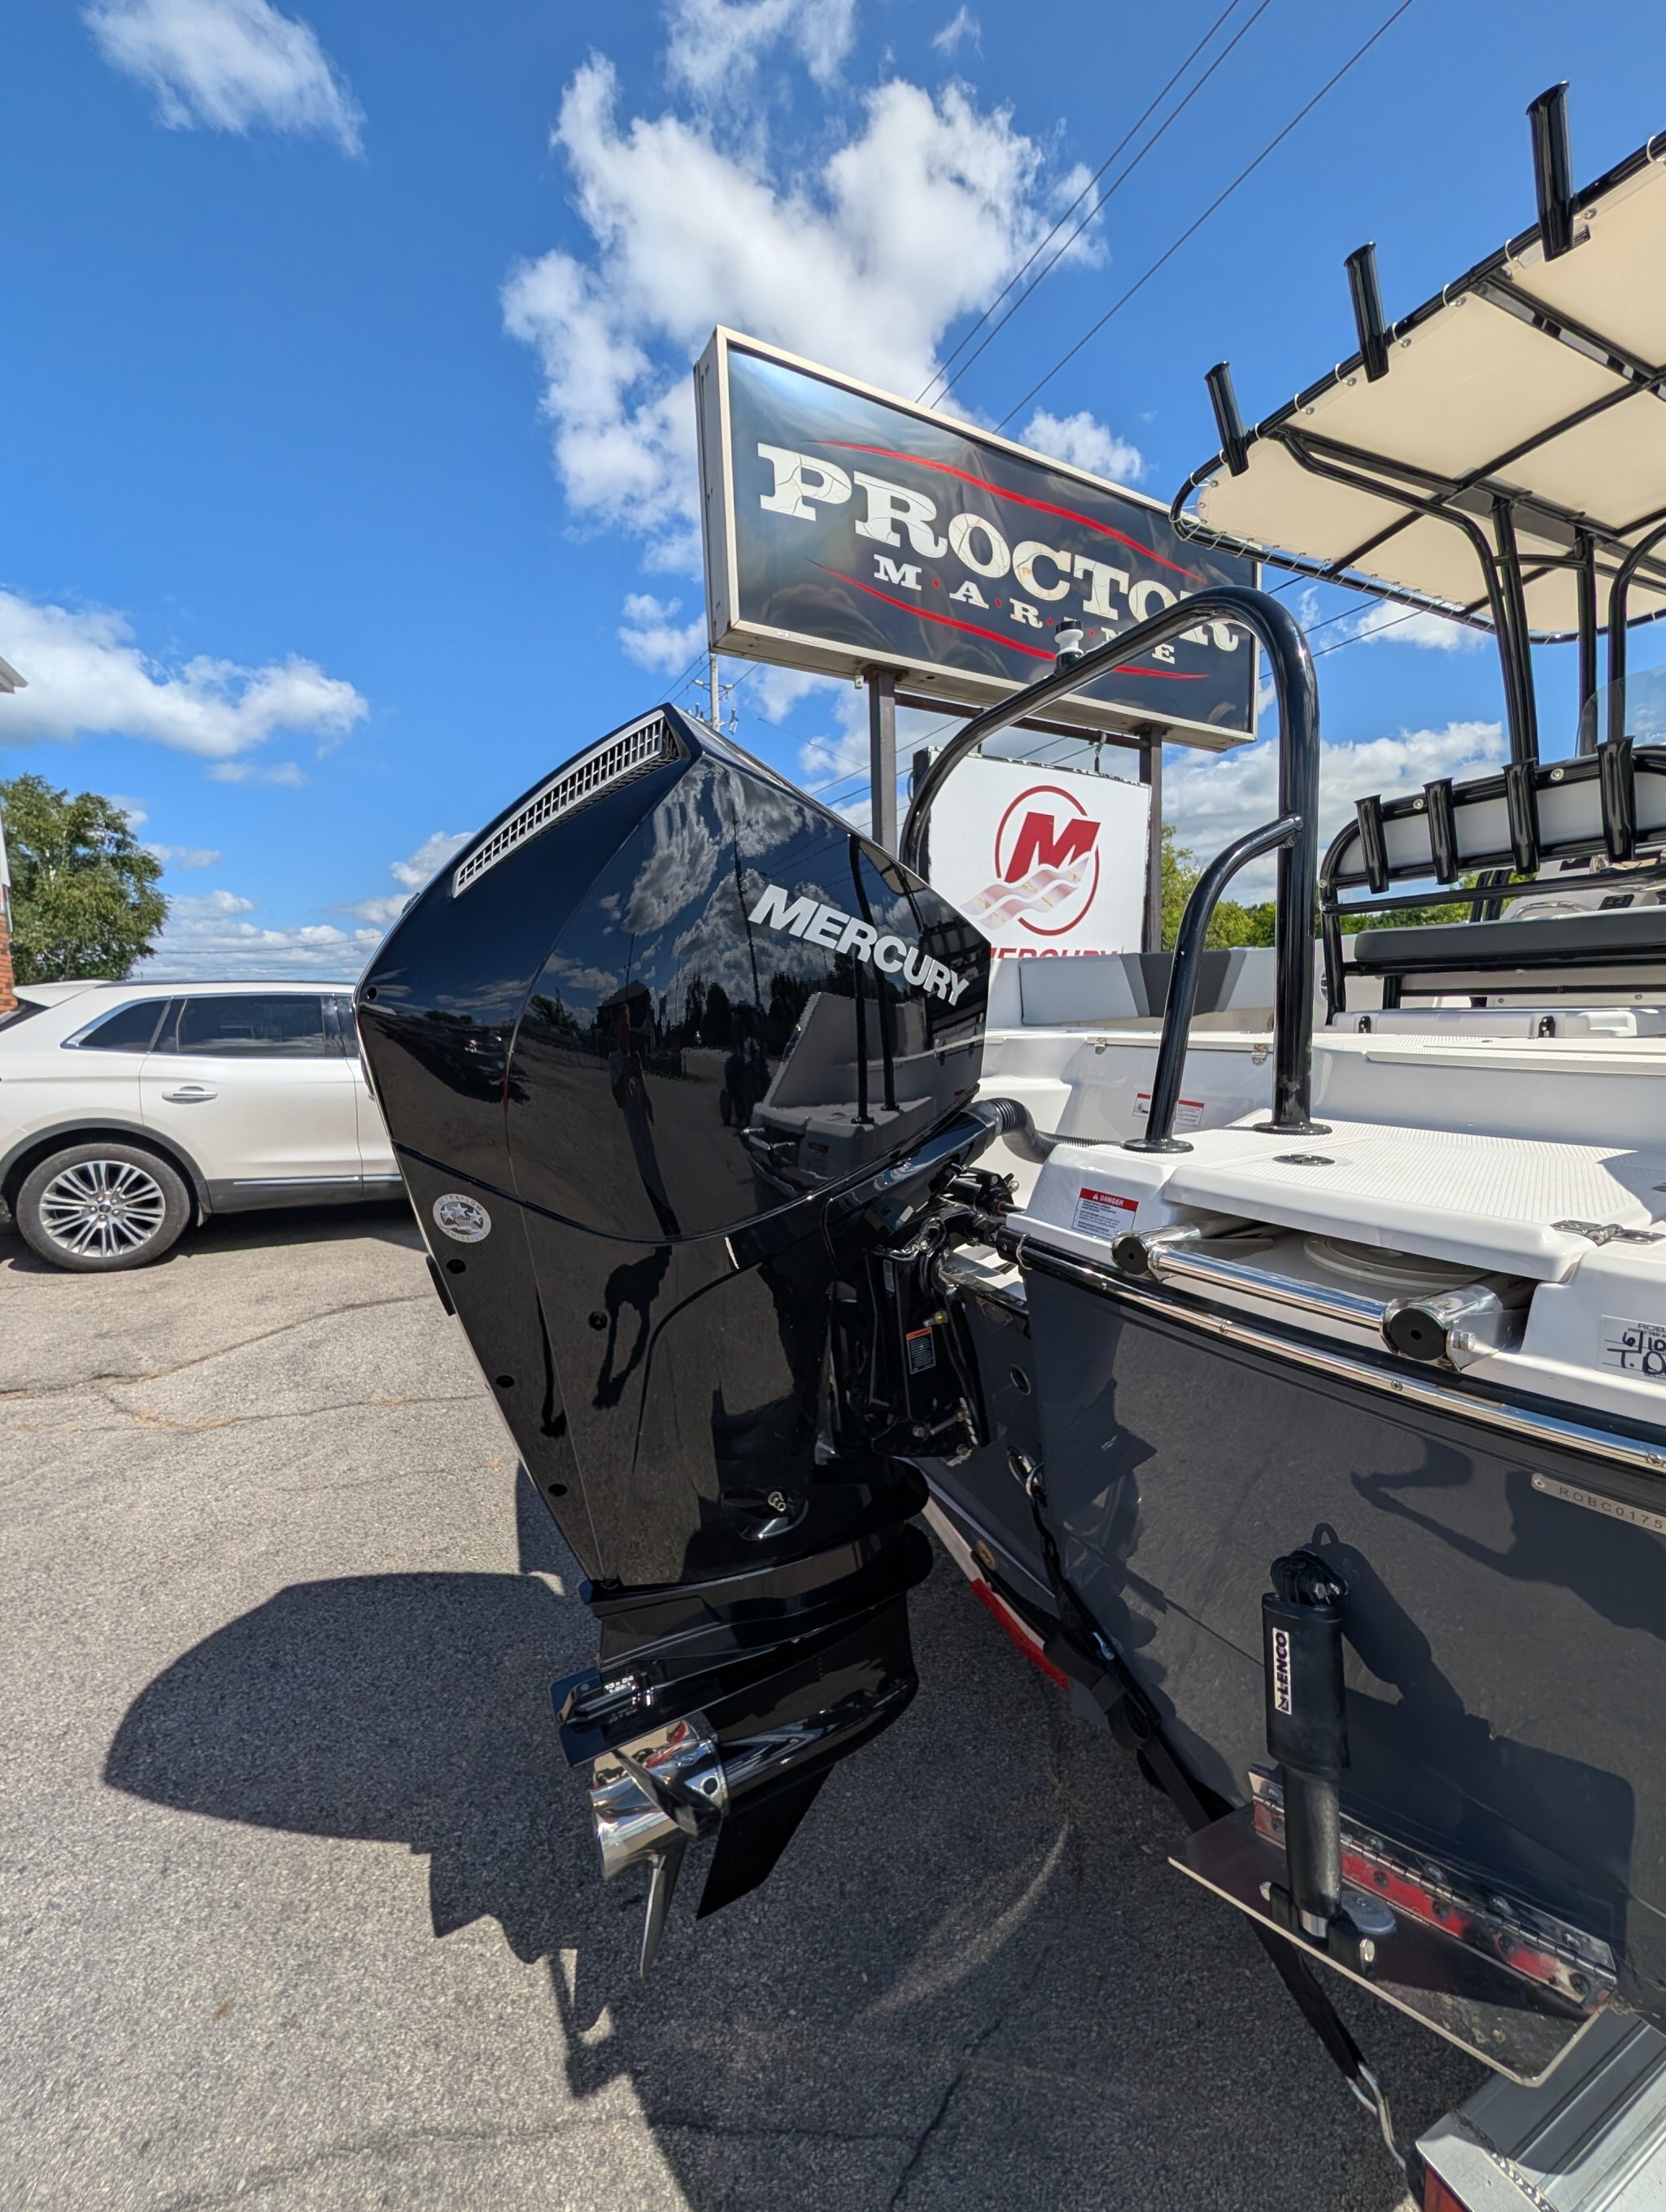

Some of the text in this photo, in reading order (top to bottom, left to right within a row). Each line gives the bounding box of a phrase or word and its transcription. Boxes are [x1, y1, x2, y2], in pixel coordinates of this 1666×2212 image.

[757, 442, 1239, 651] PROCTOR
[748, 885, 970, 1007] MERCURY
[1100, 1195, 1124, 1206] DANGER
[1638, 1323, 1666, 1333] ROB
[1559, 1487, 1663, 1530] ROBC0175
[1276, 1631, 1289, 1696] LENCO
